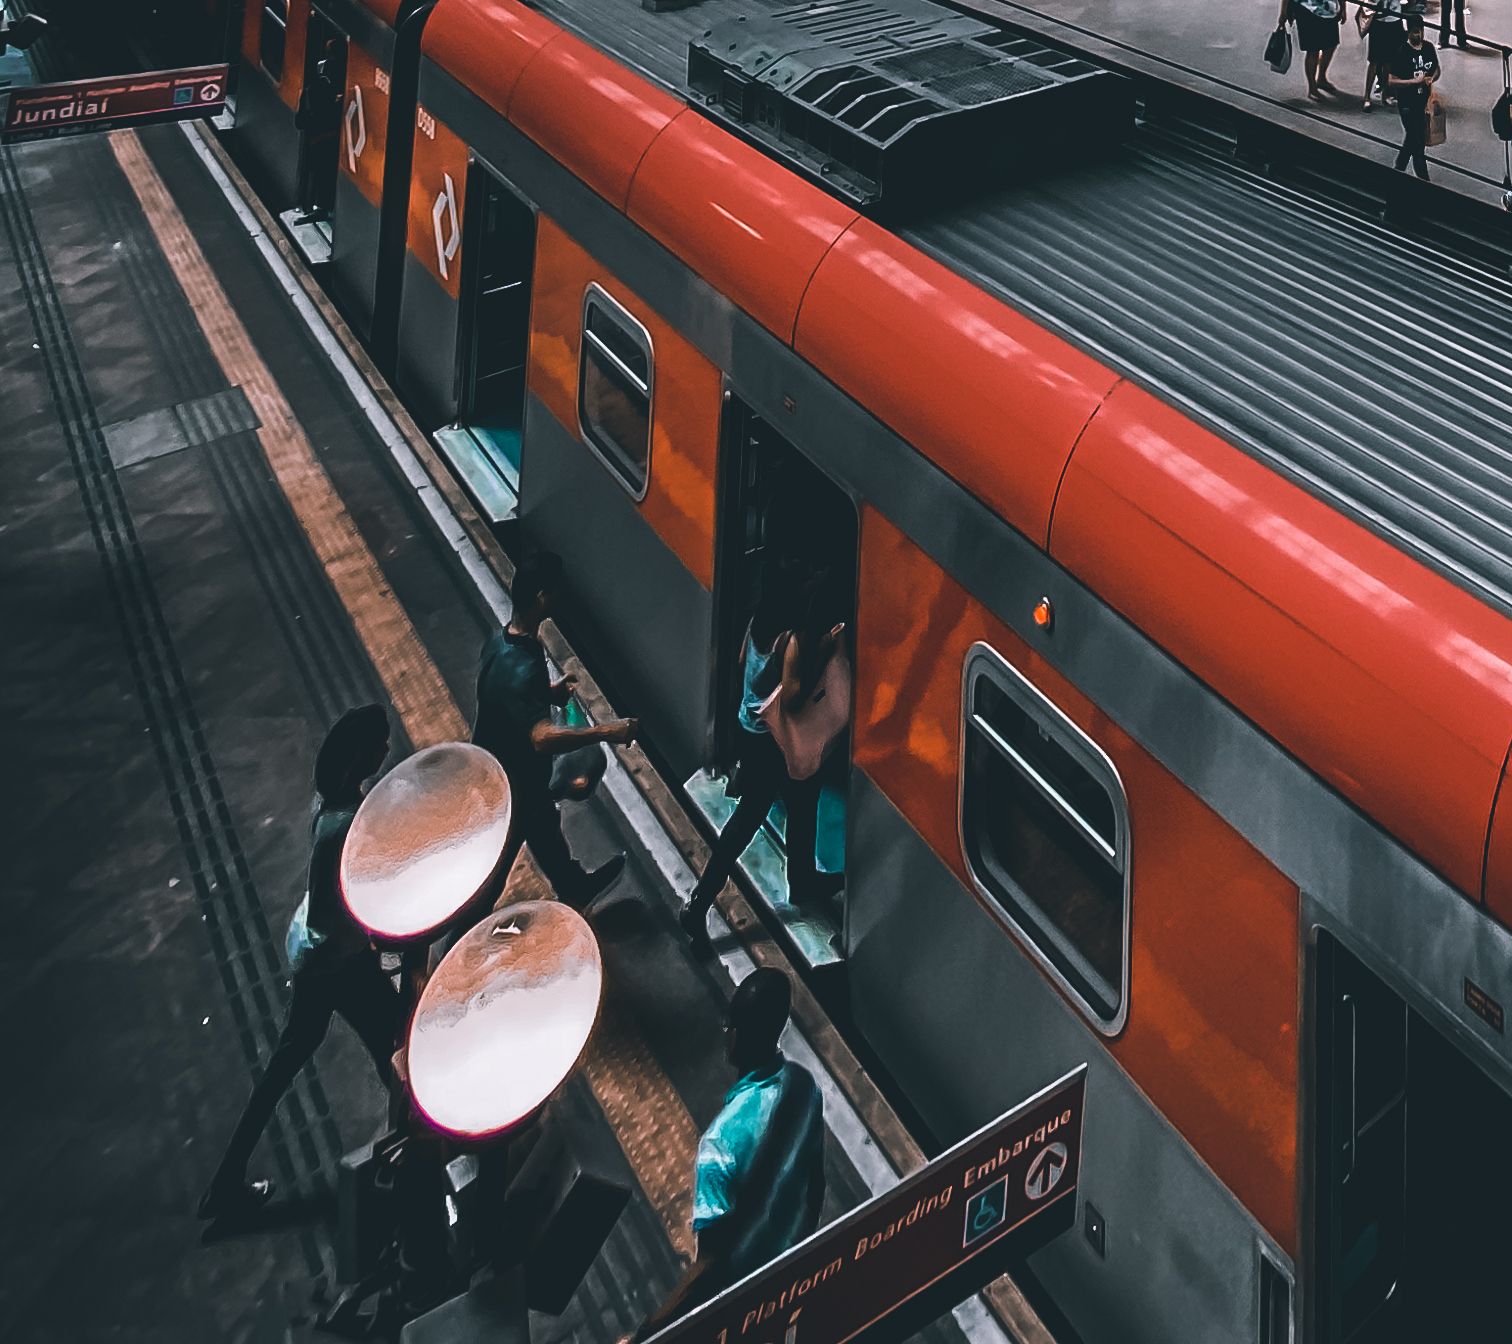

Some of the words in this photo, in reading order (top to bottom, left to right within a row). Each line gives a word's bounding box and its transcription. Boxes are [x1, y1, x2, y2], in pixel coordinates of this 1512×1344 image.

[742, 1258, 843, 1334] Platform
[855, 1185, 952, 1260] Boarding
[963, 1109, 1071, 1189] Embarque
